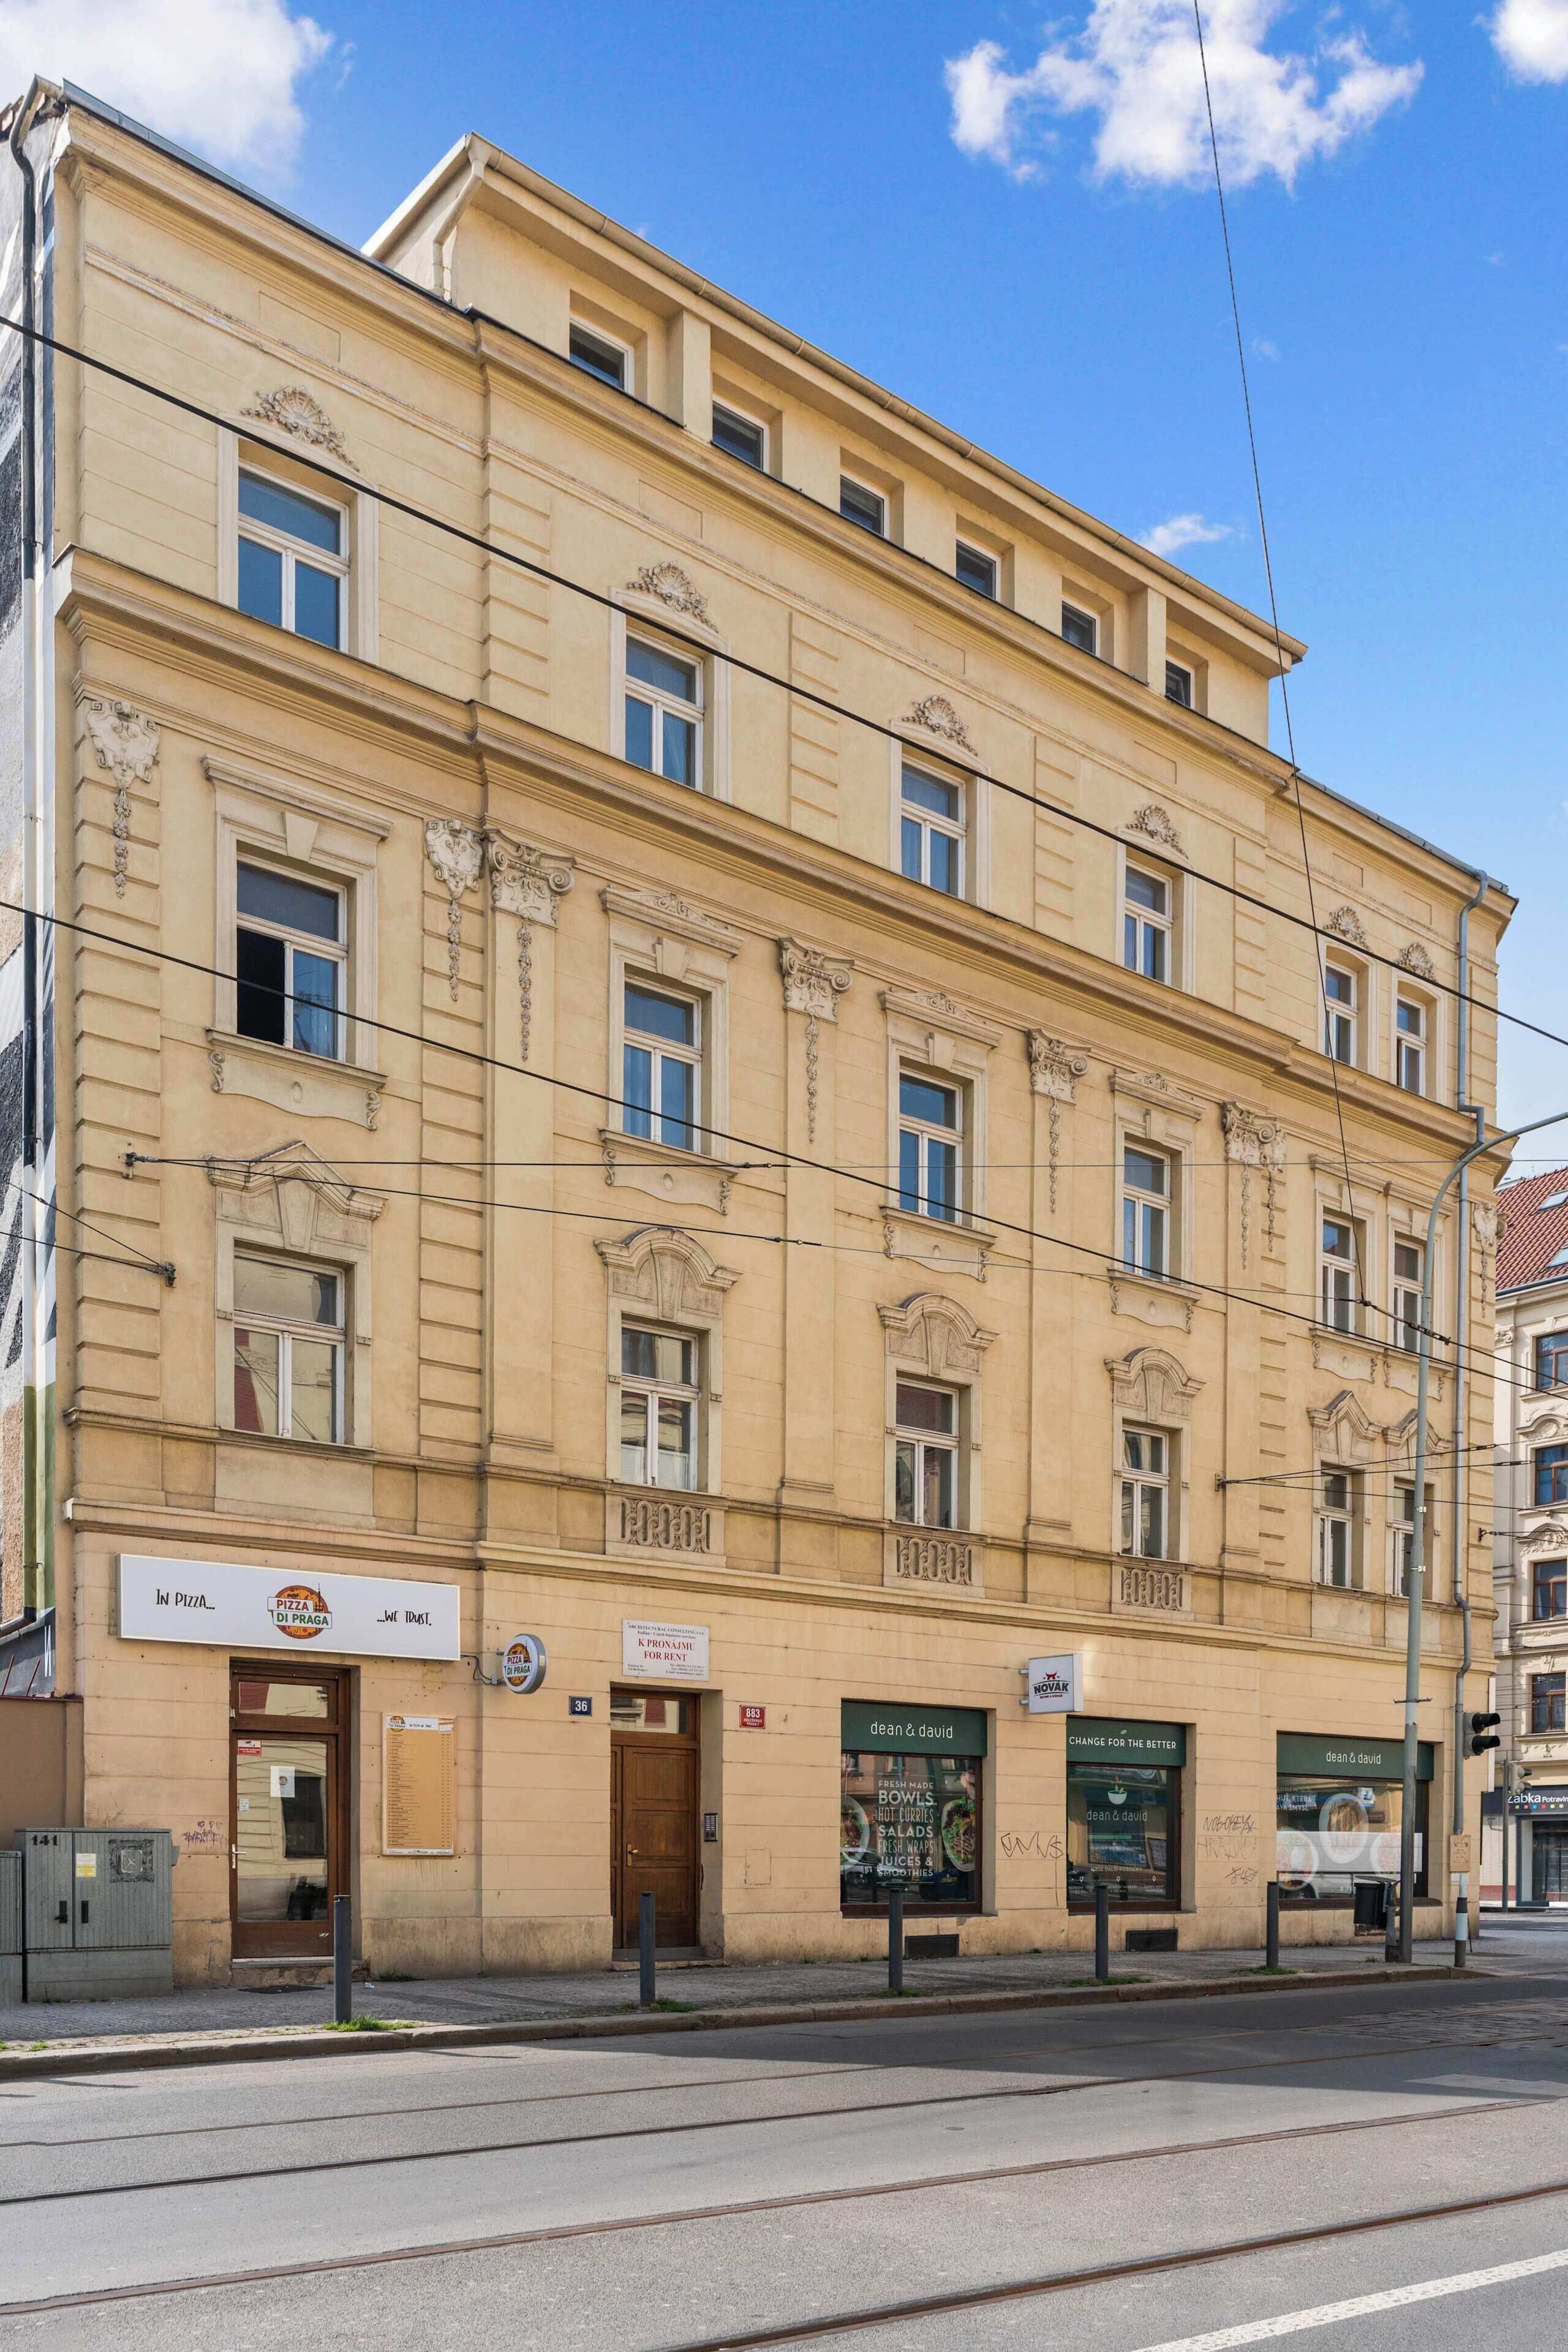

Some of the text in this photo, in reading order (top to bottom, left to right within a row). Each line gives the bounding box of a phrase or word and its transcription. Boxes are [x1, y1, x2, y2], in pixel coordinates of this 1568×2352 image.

[175, 1592, 215, 1610] PIZZA...
[276, 1599, 309, 1611] PIZZA
[277, 1613, 329, 1626] DI PRAGA
[404, 1611, 432, 1626] TRUST.
[647, 1638, 695, 1651] PRONÁJMU
[507, 1656, 522, 1664] PIZZA
[644, 1651, 687, 1662] FOR RENT
[507, 1665, 530, 1675] DI PRAGA
[1034, 1681, 1069, 1694] NOVÁK
[575, 1700, 587, 1712] 36
[746, 1708, 760, 1718] 883
[871, 1722, 953, 1738] dean & david
[1069, 1736, 1177, 1749] CHANGE FOR THE BETTER
[1326, 1751, 1381, 1764] dean & david
[878, 1790, 934, 1806] BOWLS
[878, 1807, 933, 1823] HOT CURRIES
[1087, 1809, 1147, 1822] dean & david
[878, 1825, 933, 1838] SALADS
[31, 1834, 58, 1845] 141
[878, 1839, 933, 1853] FRESH WRAPS
[880, 1856, 933, 1866] JUICES &
[878, 1868, 933, 1877] SMOOTHIES
